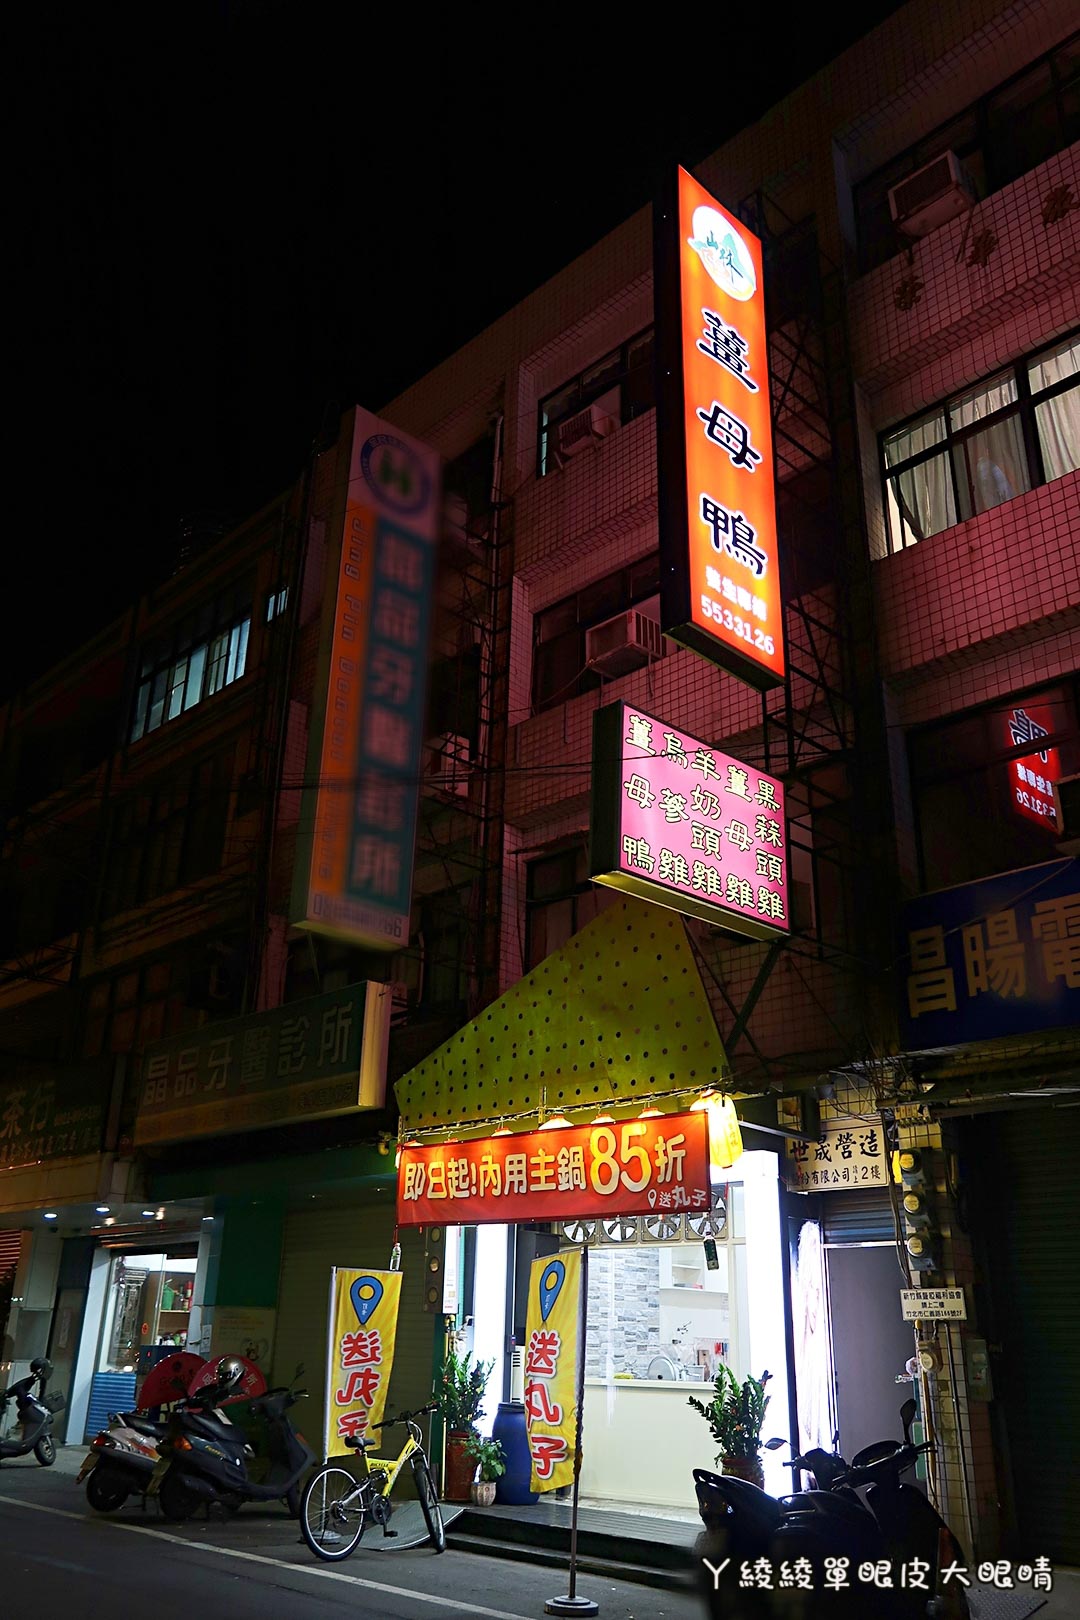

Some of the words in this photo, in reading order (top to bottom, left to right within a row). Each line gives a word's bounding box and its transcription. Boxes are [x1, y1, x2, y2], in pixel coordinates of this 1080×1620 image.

[697, 308, 767, 578] 薑母鴨
[701, 594, 775, 655] 5533126
[623, 715, 656, 874] 薑母鴨
[691, 748, 724, 897] 羊奶頭雞
[724, 765, 756, 909] 薑母雞
[754, 779, 786, 920] 黑蒜頭雞
[658, 1185, 706, 1209] 送丸子
[797, 1167, 850, 1186] 份有限公司
[524, 1329, 568, 1480] 送丸子
